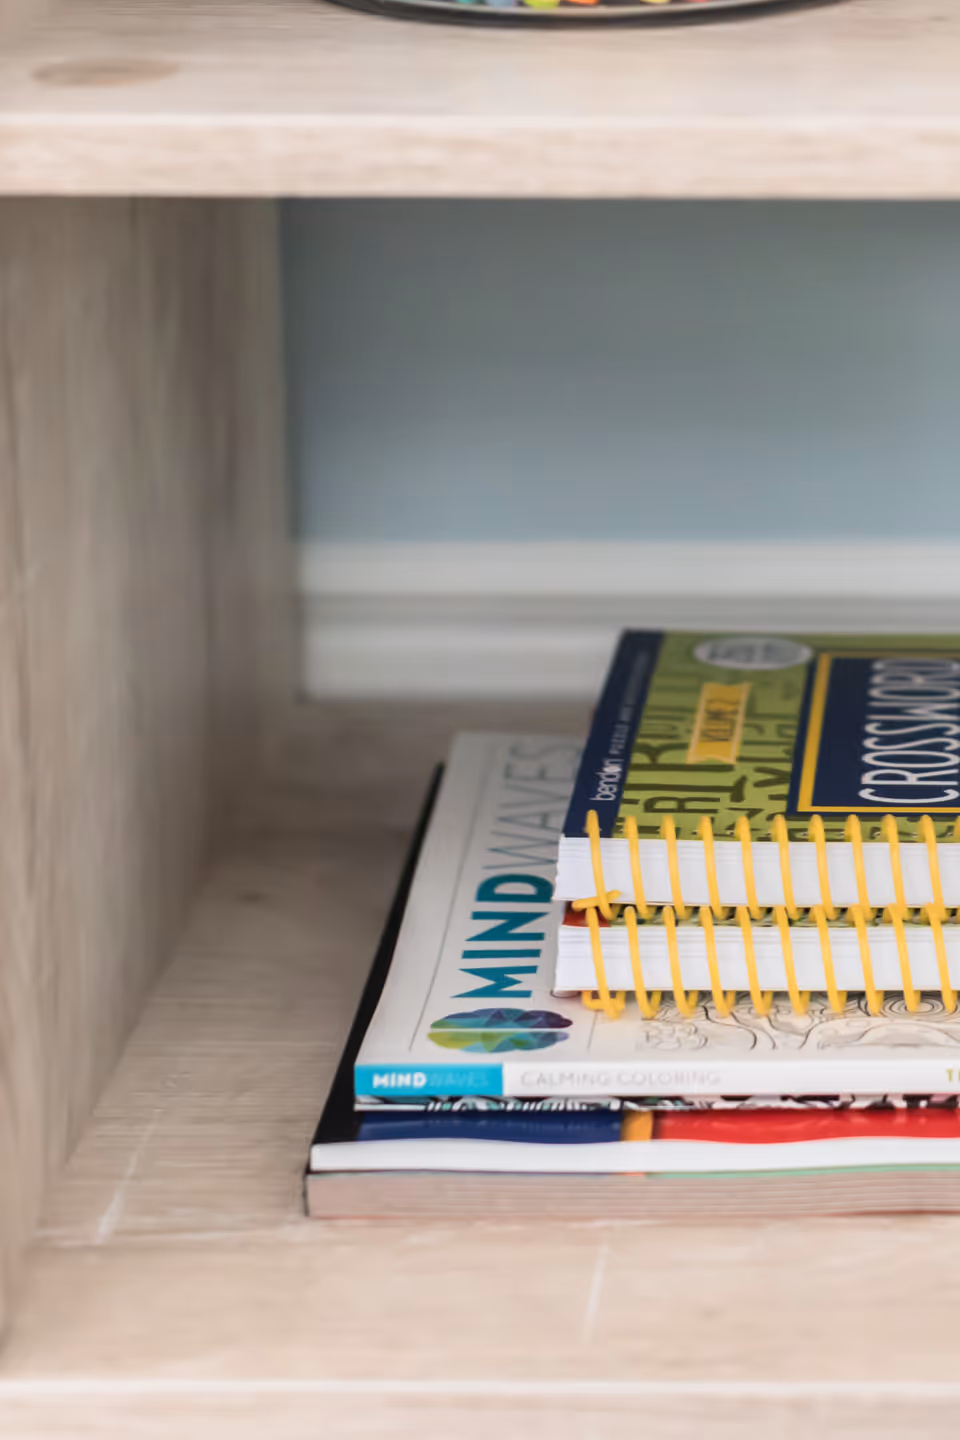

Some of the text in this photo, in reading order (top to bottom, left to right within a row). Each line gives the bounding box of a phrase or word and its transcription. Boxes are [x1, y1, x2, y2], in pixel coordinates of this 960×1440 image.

[589, 759, 624, 801] bendon
[520, 1071, 721, 1087] CALMING COLORING
